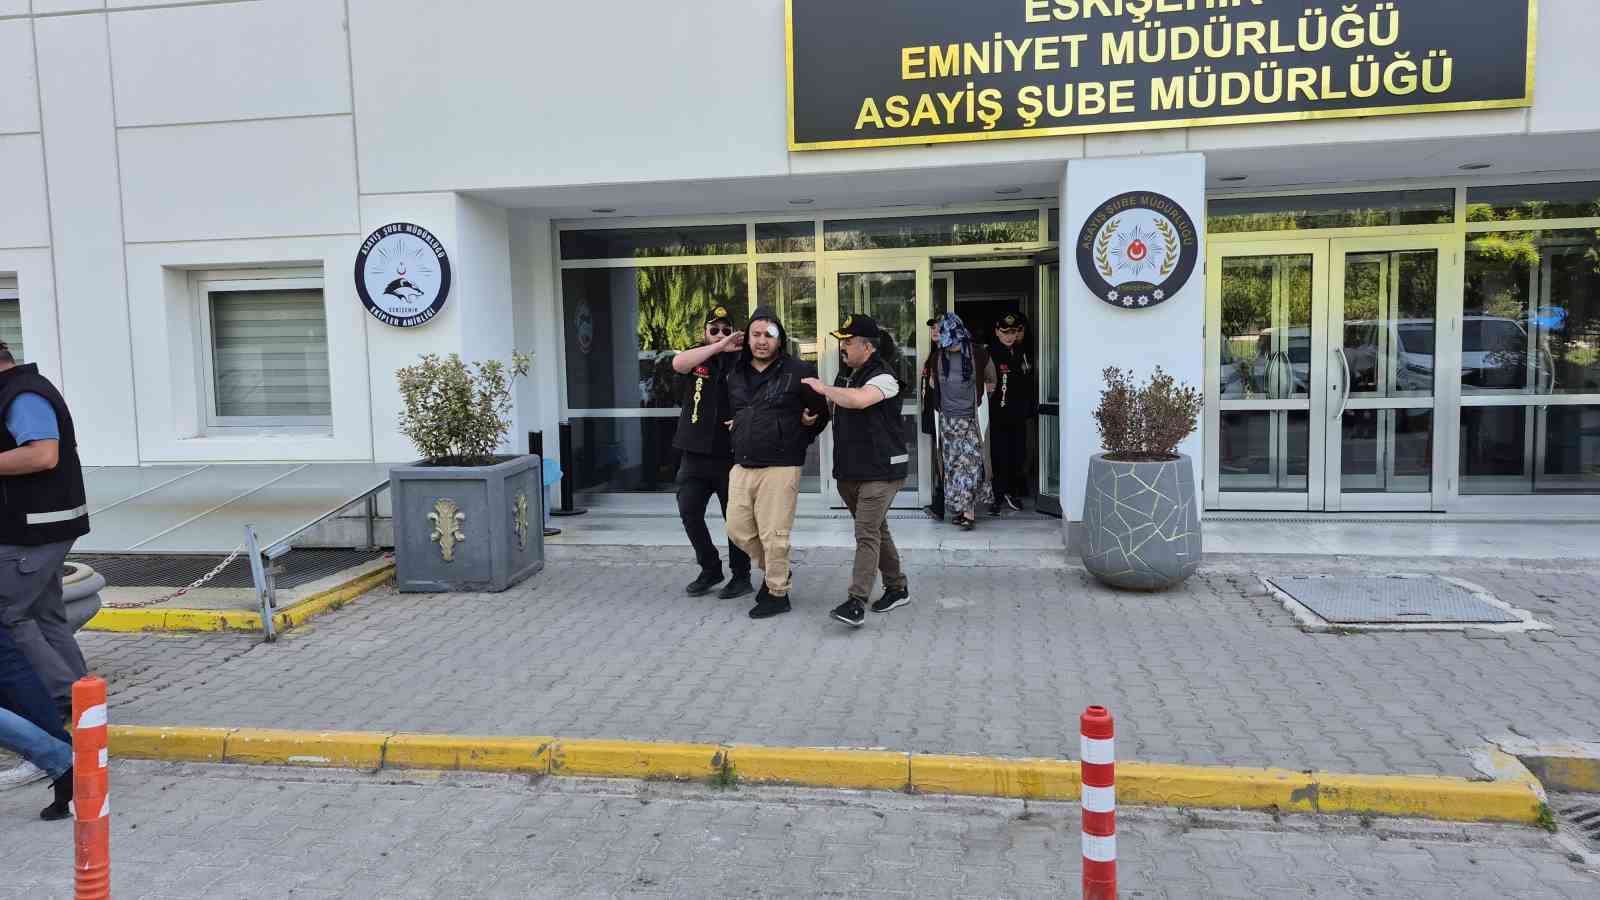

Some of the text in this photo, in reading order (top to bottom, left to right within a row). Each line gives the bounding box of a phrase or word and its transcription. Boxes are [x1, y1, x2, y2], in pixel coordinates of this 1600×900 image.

[901, 3, 1400, 80] EMNİYET MÜDÜRLÜĞÜ
[854, 49, 1453, 130] ASAYİŞ ŞUBE MÜDÜRLÜĞÜ
